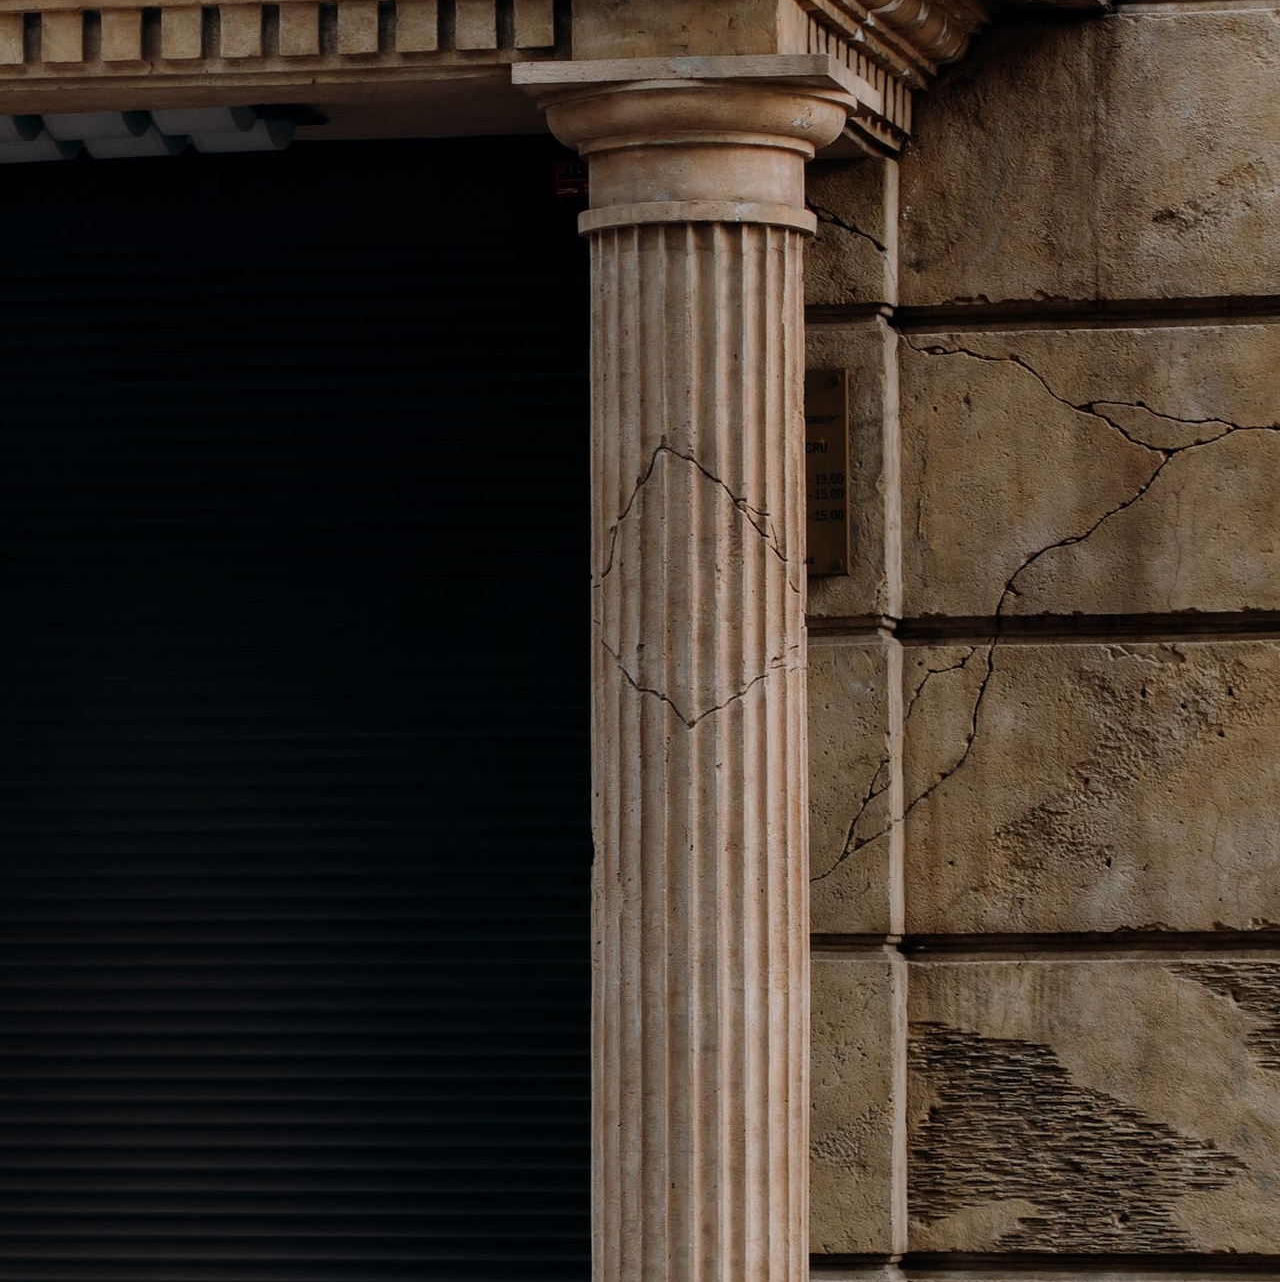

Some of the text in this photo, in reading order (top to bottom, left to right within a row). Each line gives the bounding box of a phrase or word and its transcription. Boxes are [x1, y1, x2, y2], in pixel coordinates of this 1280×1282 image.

[815, 473, 844, 485] 19.00
[815, 488, 844, 500] 15.00
[815, 509, 845, 521] 15.00
